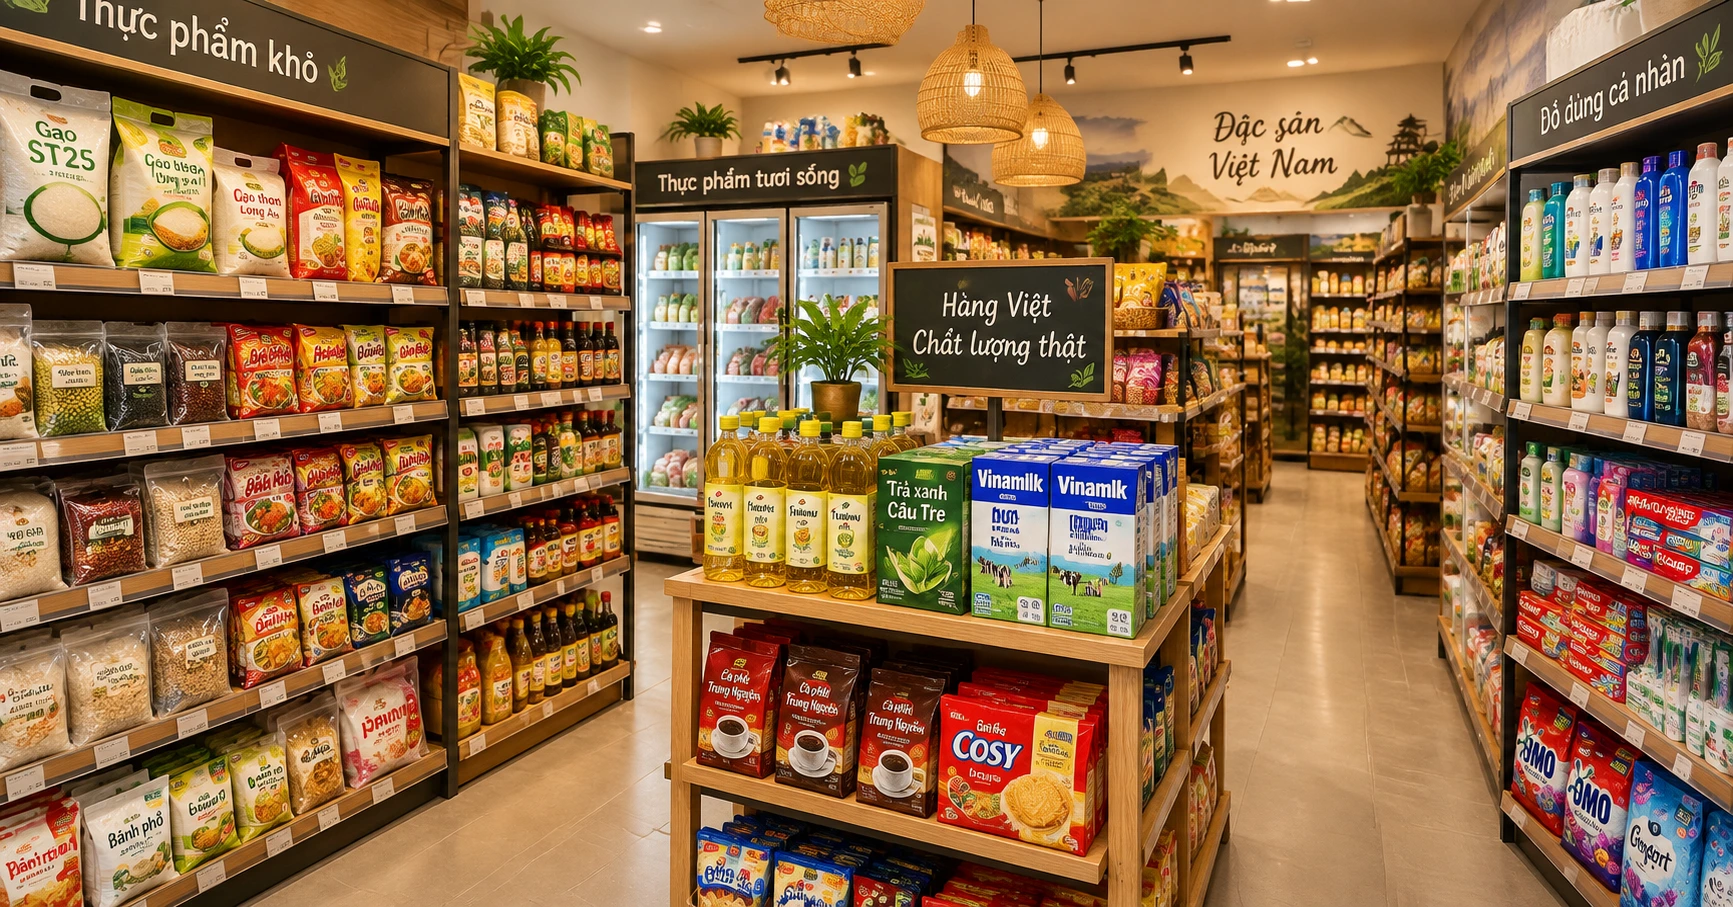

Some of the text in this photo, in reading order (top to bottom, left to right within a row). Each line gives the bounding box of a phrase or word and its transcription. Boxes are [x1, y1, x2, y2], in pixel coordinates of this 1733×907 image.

[1608, 71, 1629, 107] cá
[28, 139, 96, 171] ST25
[1270, 147, 1338, 179] Nam
[657, 173, 697, 196] Thực
[755, 167, 790, 188] tươi
[796, 163, 840, 190] sống
[942, 291, 1052, 327] Hàng Việt
[970, 329, 1031, 366] lượng
[1038, 330, 1087, 364] thật
[914, 484, 947, 501] xanh
[887, 501, 917, 520] Câu
[920, 503, 946, 522] Tre
[952, 730, 1023, 771] COSY
[108, 824, 140, 849] Bánh
